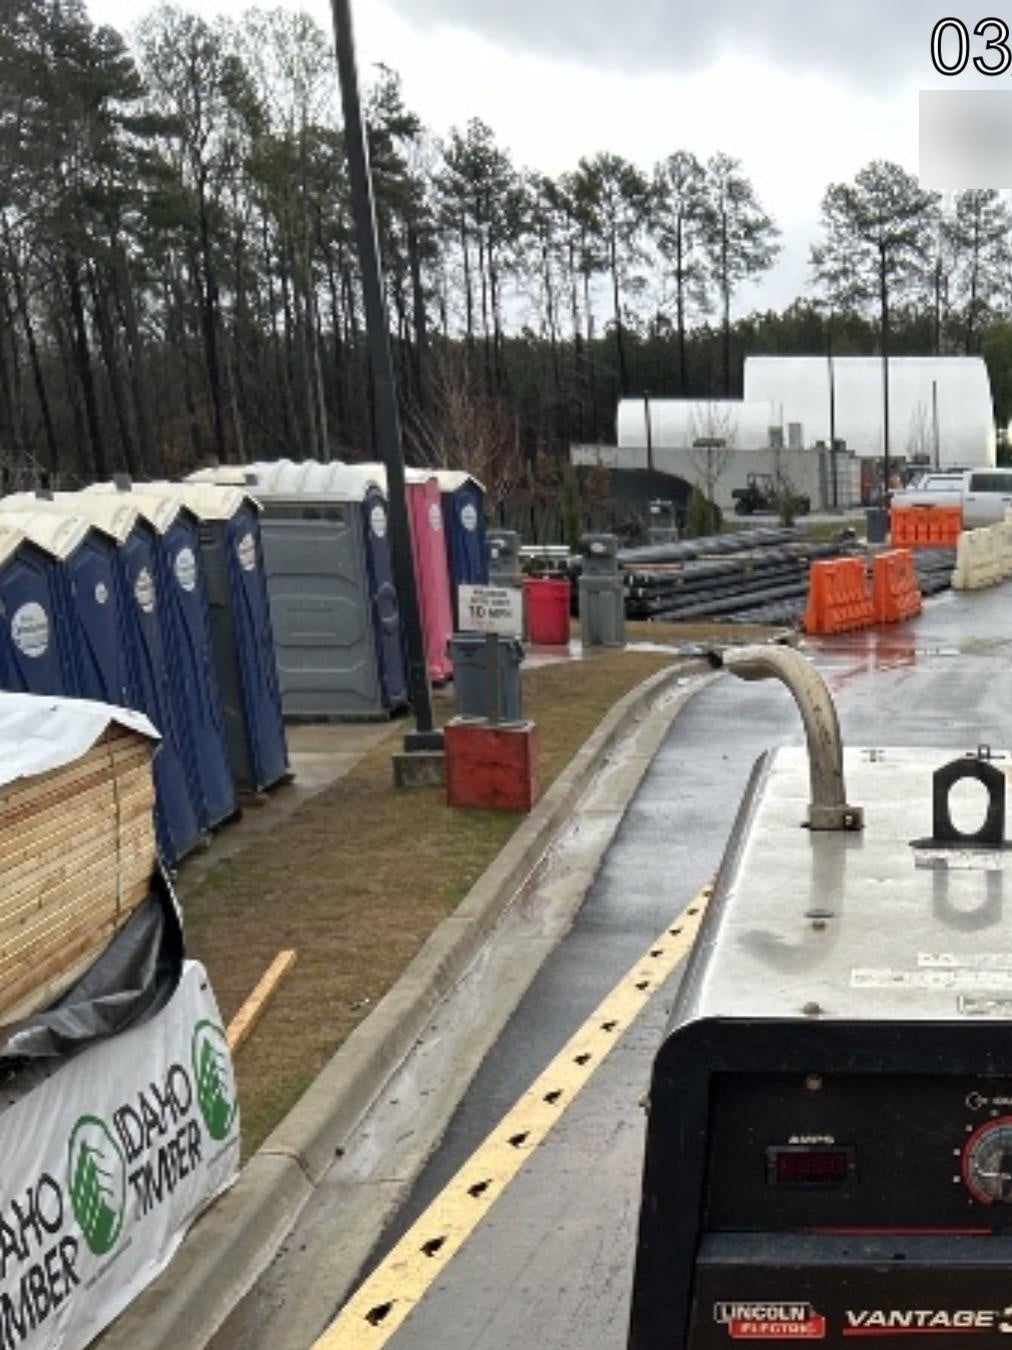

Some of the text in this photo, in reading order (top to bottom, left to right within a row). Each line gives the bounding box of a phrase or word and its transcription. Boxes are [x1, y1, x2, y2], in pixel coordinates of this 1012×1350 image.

[468, 605, 486, 618] 10
[113, 1064, 192, 1165] IDAHO
[787, 1134, 835, 1144] AMPS
[128, 1119, 203, 1221] TIMBER
[720, 1305, 805, 1321] LINCOLN
[845, 1310, 995, 1327] VANTAGE
[740, 1322, 817, 1334] ELECTRIC
